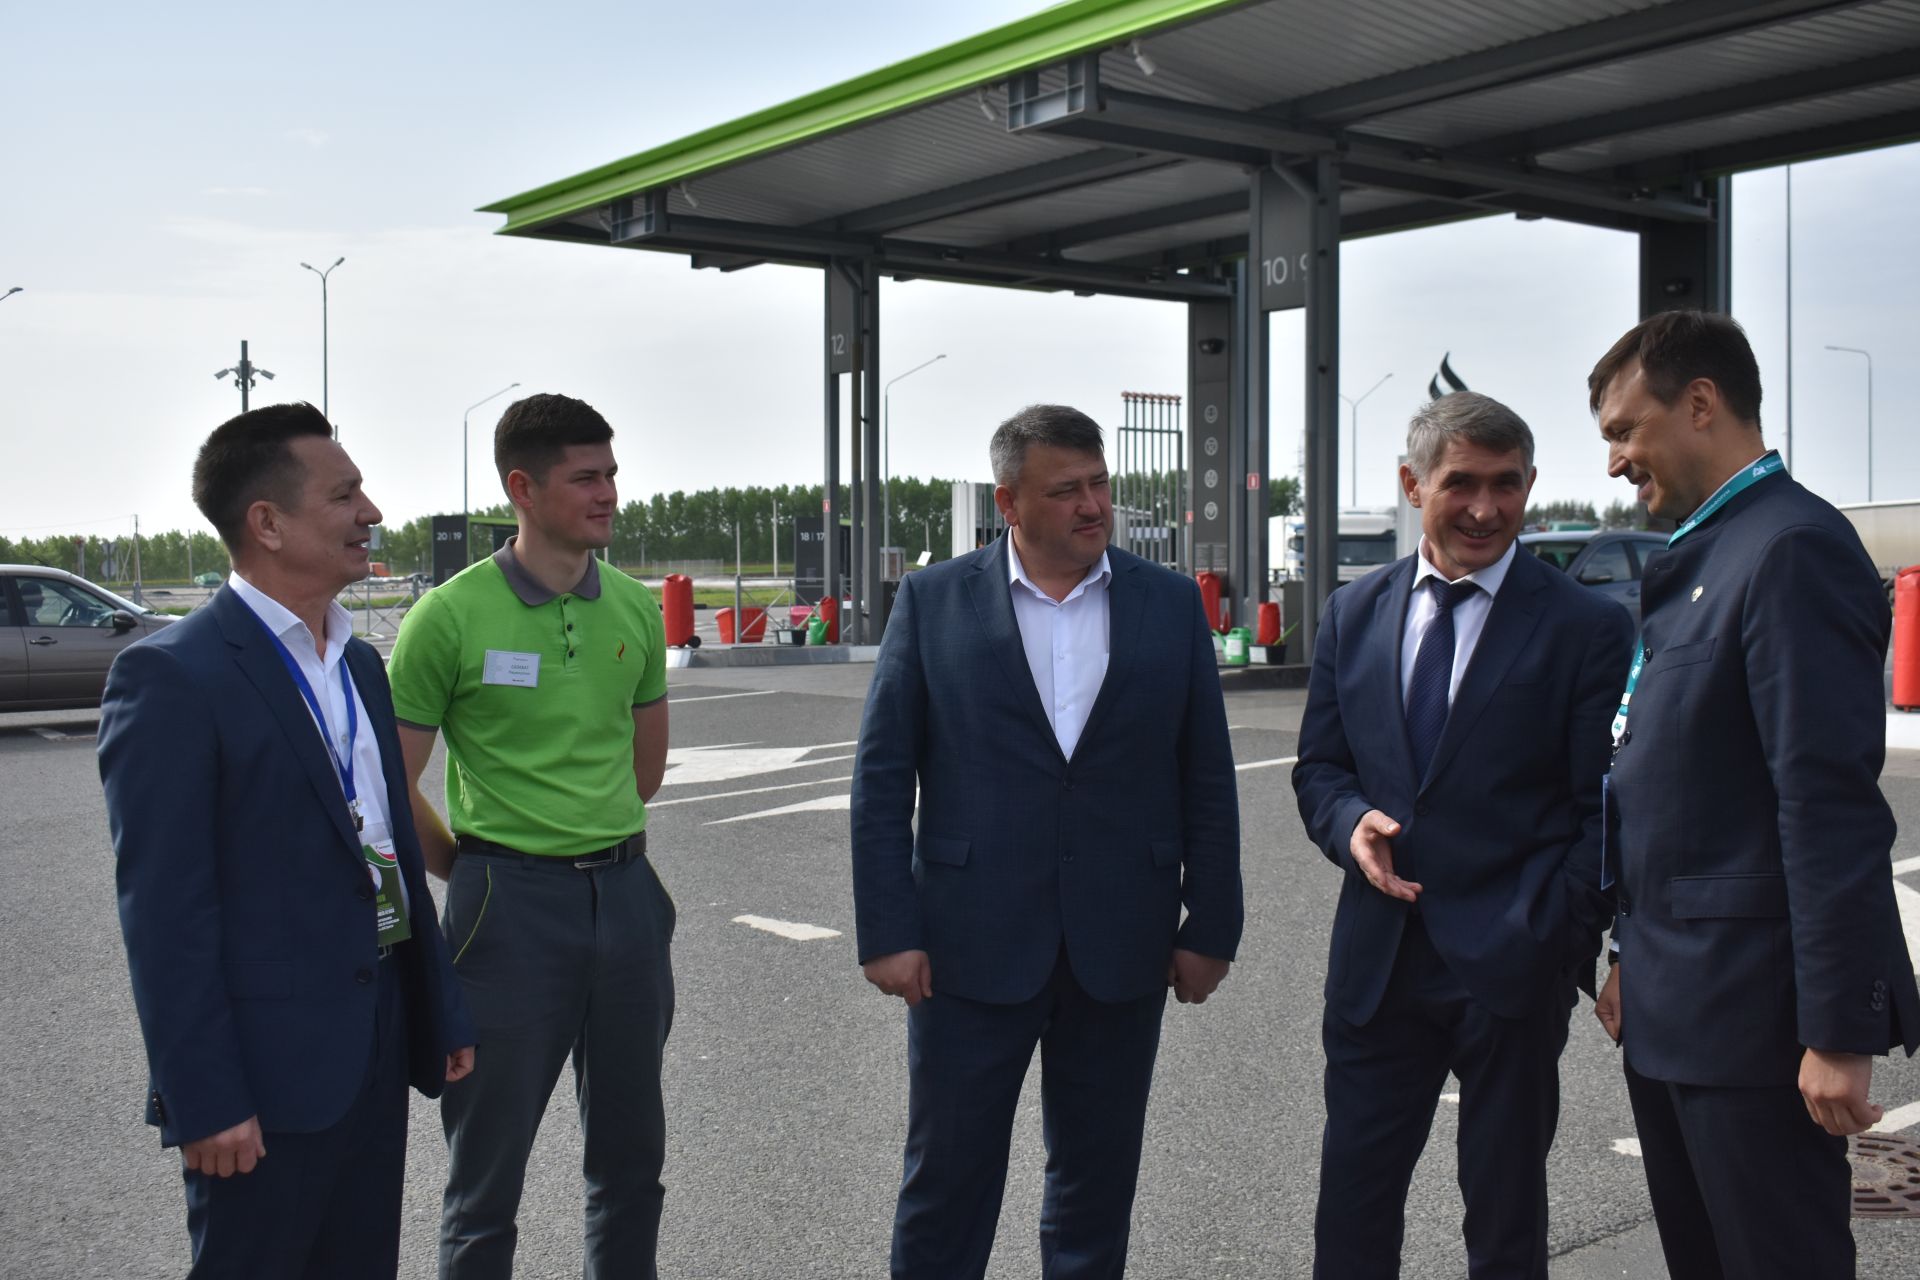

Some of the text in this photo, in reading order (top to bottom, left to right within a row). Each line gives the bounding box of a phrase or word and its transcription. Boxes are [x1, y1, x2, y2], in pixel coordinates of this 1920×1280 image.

[1263, 256, 1288, 286] 10
[831, 334, 844, 355] 12
[436, 531, 462, 541] 20 19
[800, 532, 825, 541] 18 17
